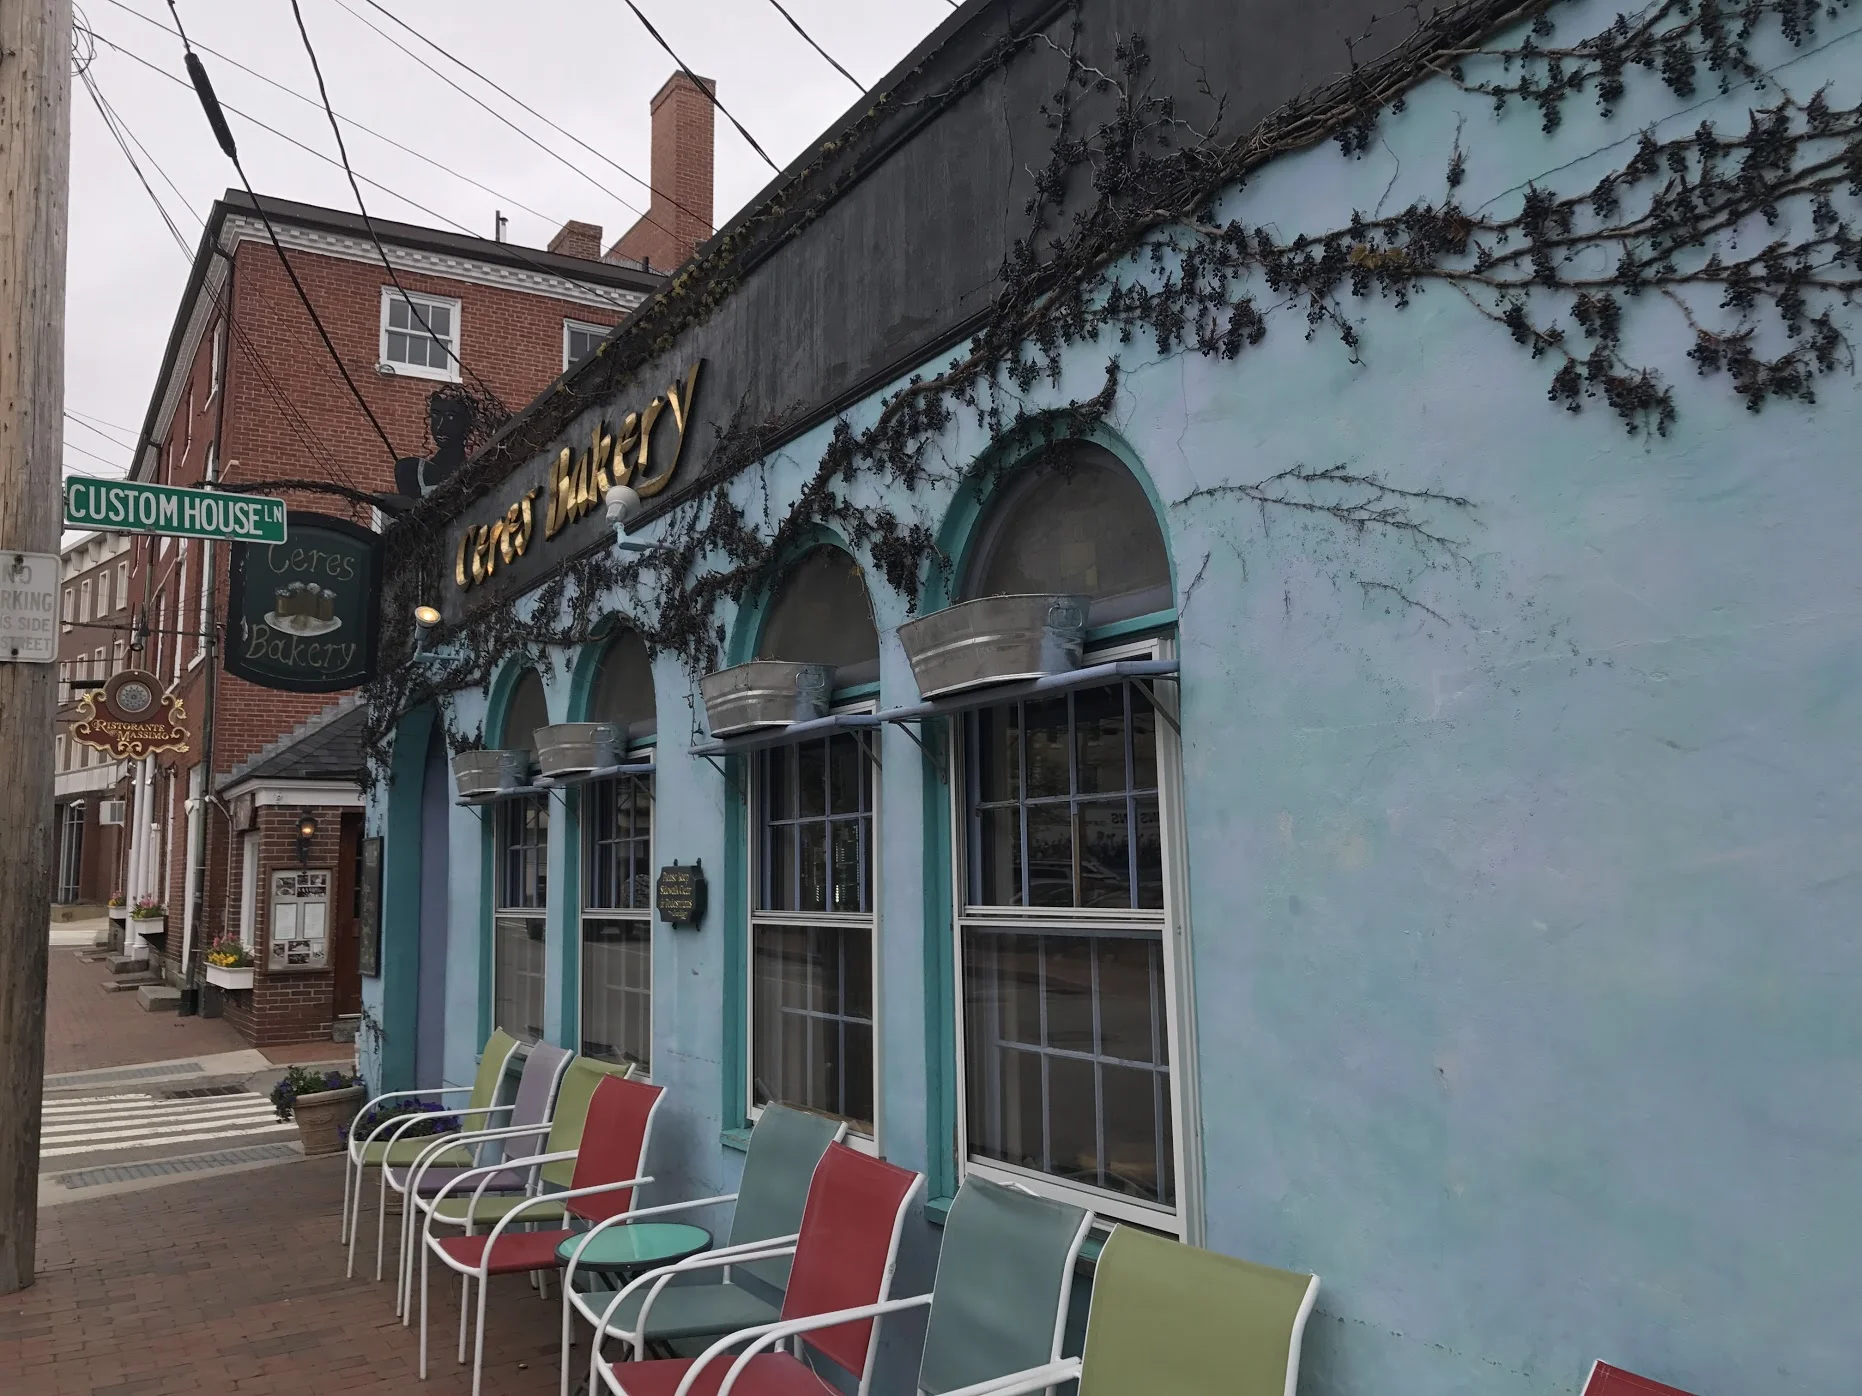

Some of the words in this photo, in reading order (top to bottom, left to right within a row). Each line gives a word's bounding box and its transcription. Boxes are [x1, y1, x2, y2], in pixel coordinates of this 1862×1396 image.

[456, 486, 540, 592] Ceres
[545, 358, 705, 540] Bakery
[69, 484, 178, 527] CUSTOM
[184, 496, 263, 535] HOUSE
[264, 504, 283, 523] LN
[268, 544, 355, 581] Ceres
[0, 590, 52, 612] RKING
[18, 617, 50, 632] SIDE
[245, 623, 356, 673] Bakery
[91, 719, 165, 736] RISTORANTE
[117, 731, 169, 741] MASSIMO
